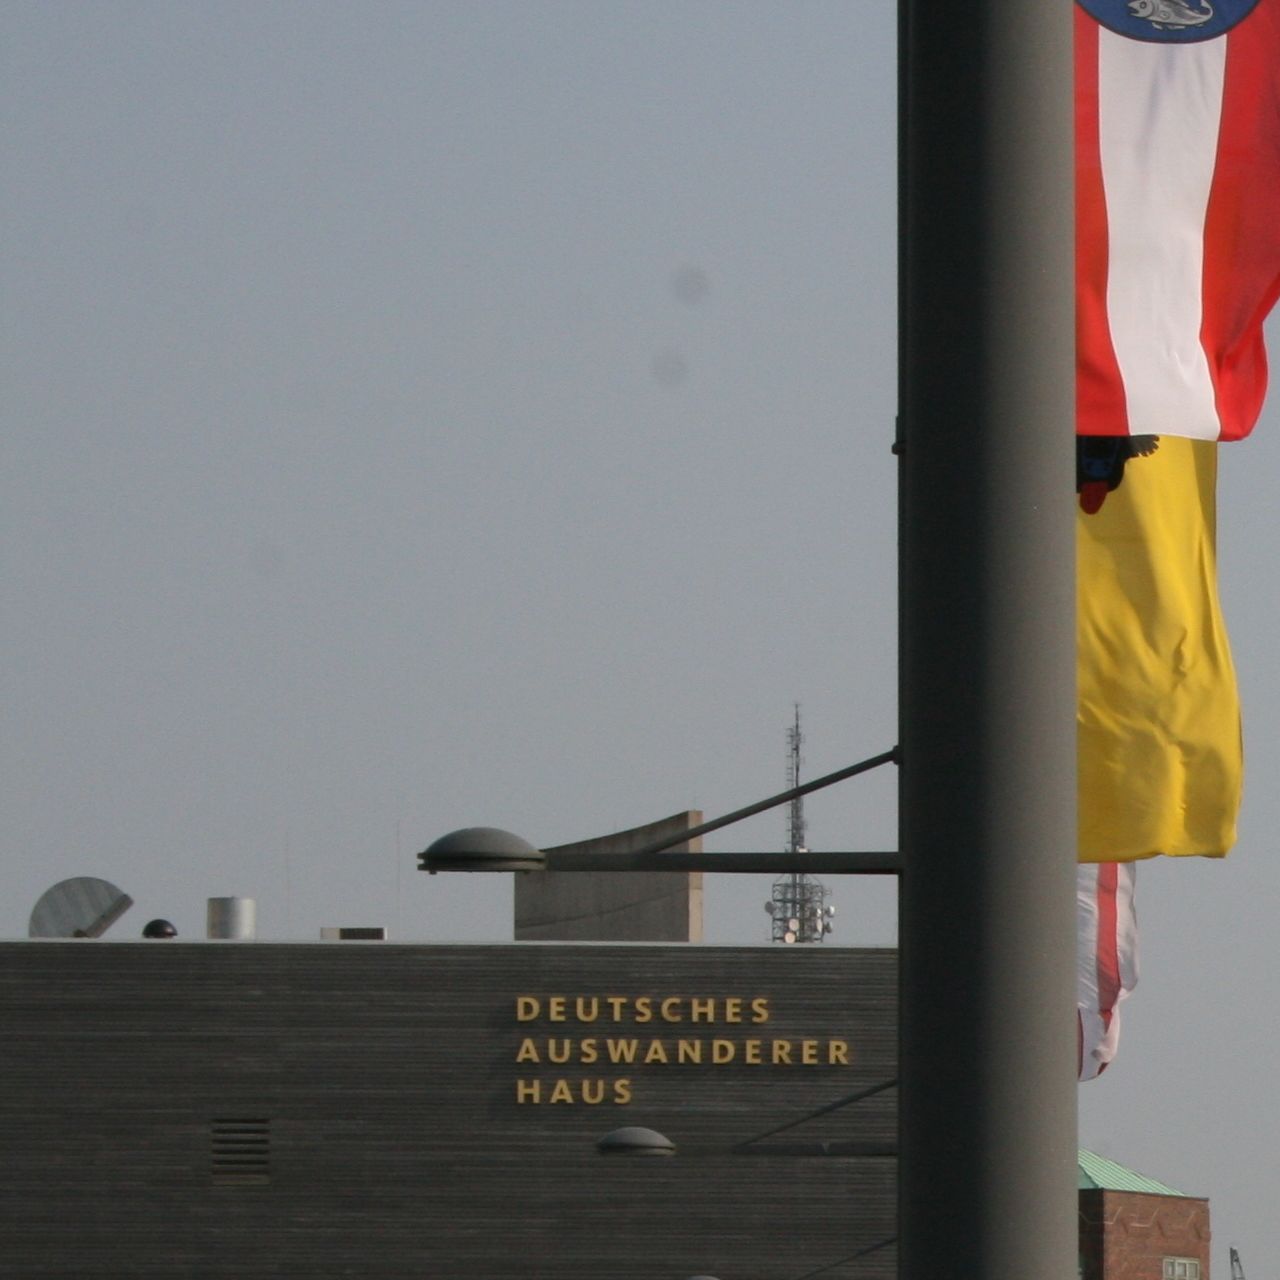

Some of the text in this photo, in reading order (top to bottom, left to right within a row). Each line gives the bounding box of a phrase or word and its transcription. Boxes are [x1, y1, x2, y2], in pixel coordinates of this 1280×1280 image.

[516, 996, 770, 1023] DEUTSCHES
[516, 1037, 850, 1065] AUSWANDERER
[516, 1078, 633, 1105] HAUS
